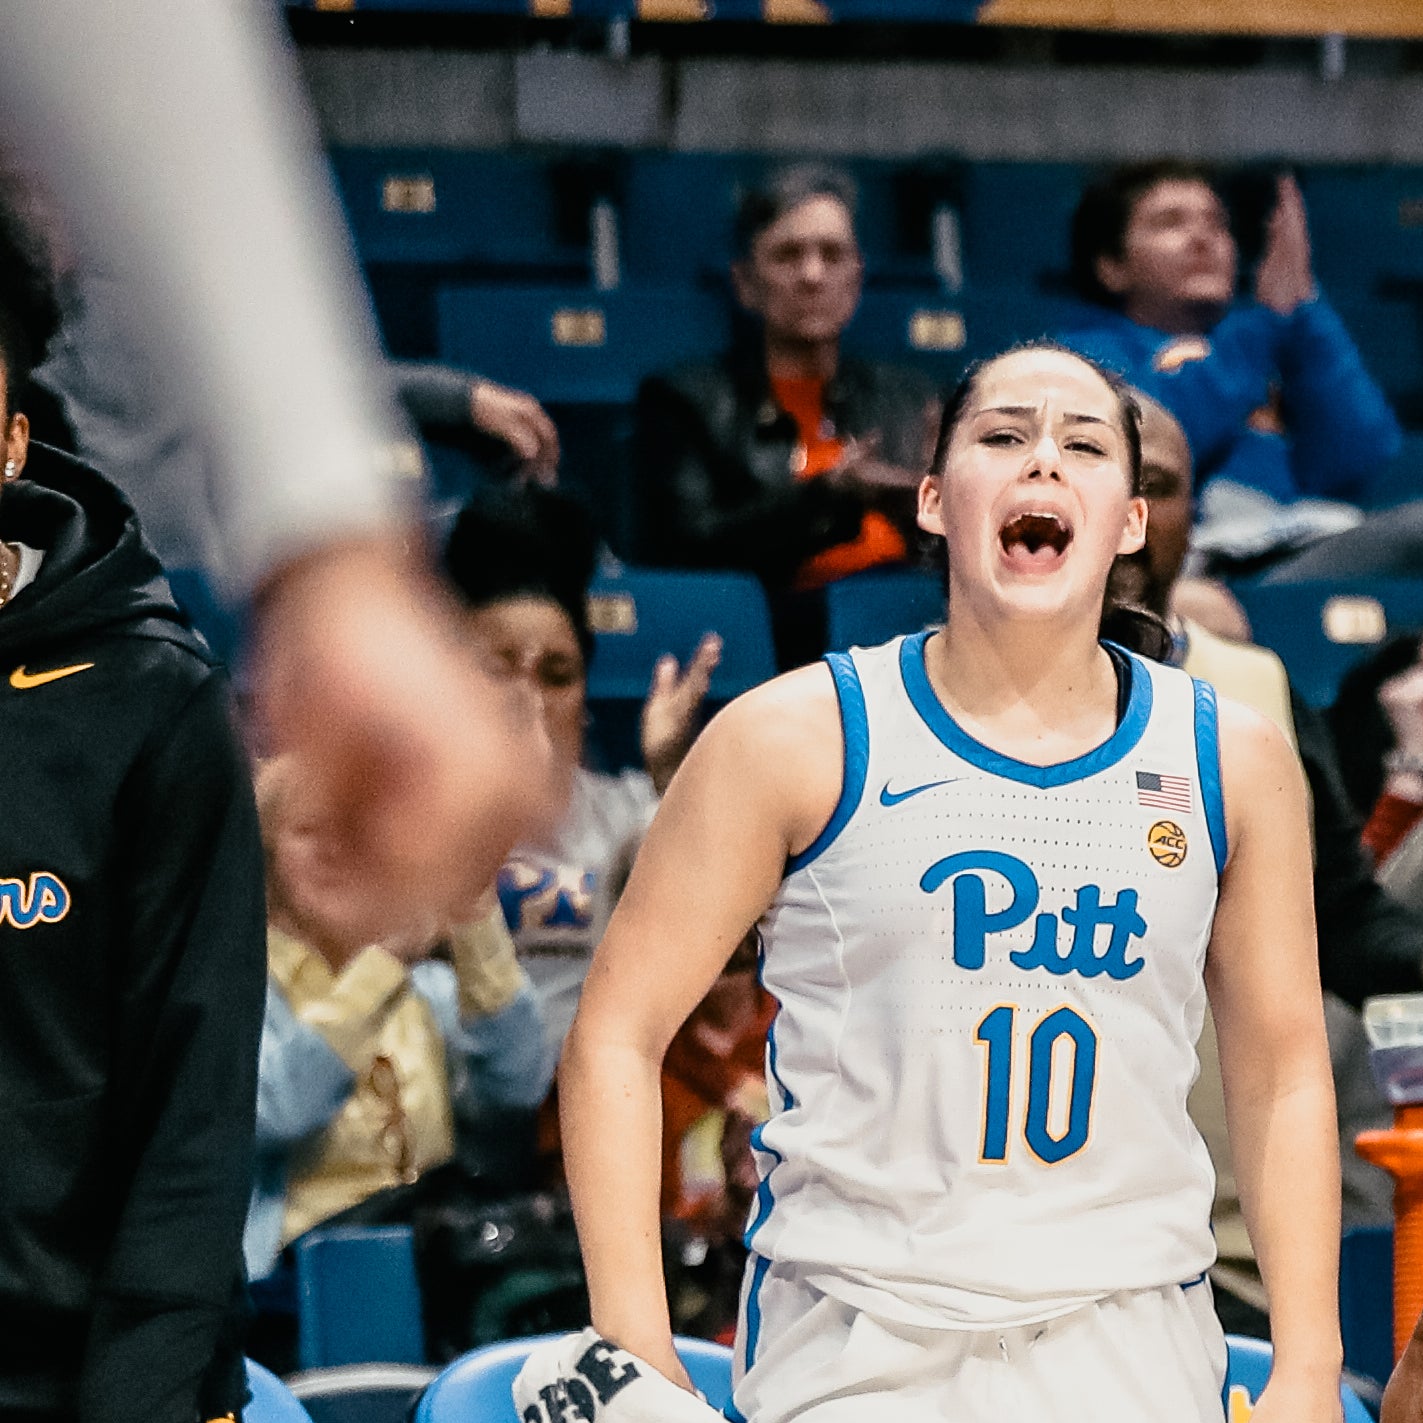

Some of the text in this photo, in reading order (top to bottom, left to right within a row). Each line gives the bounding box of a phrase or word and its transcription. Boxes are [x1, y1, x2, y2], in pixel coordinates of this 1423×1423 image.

[1153, 835, 1185, 850] ACC
[920, 850, 1147, 980] Pitt
[972, 1003, 1101, 1168] 10
